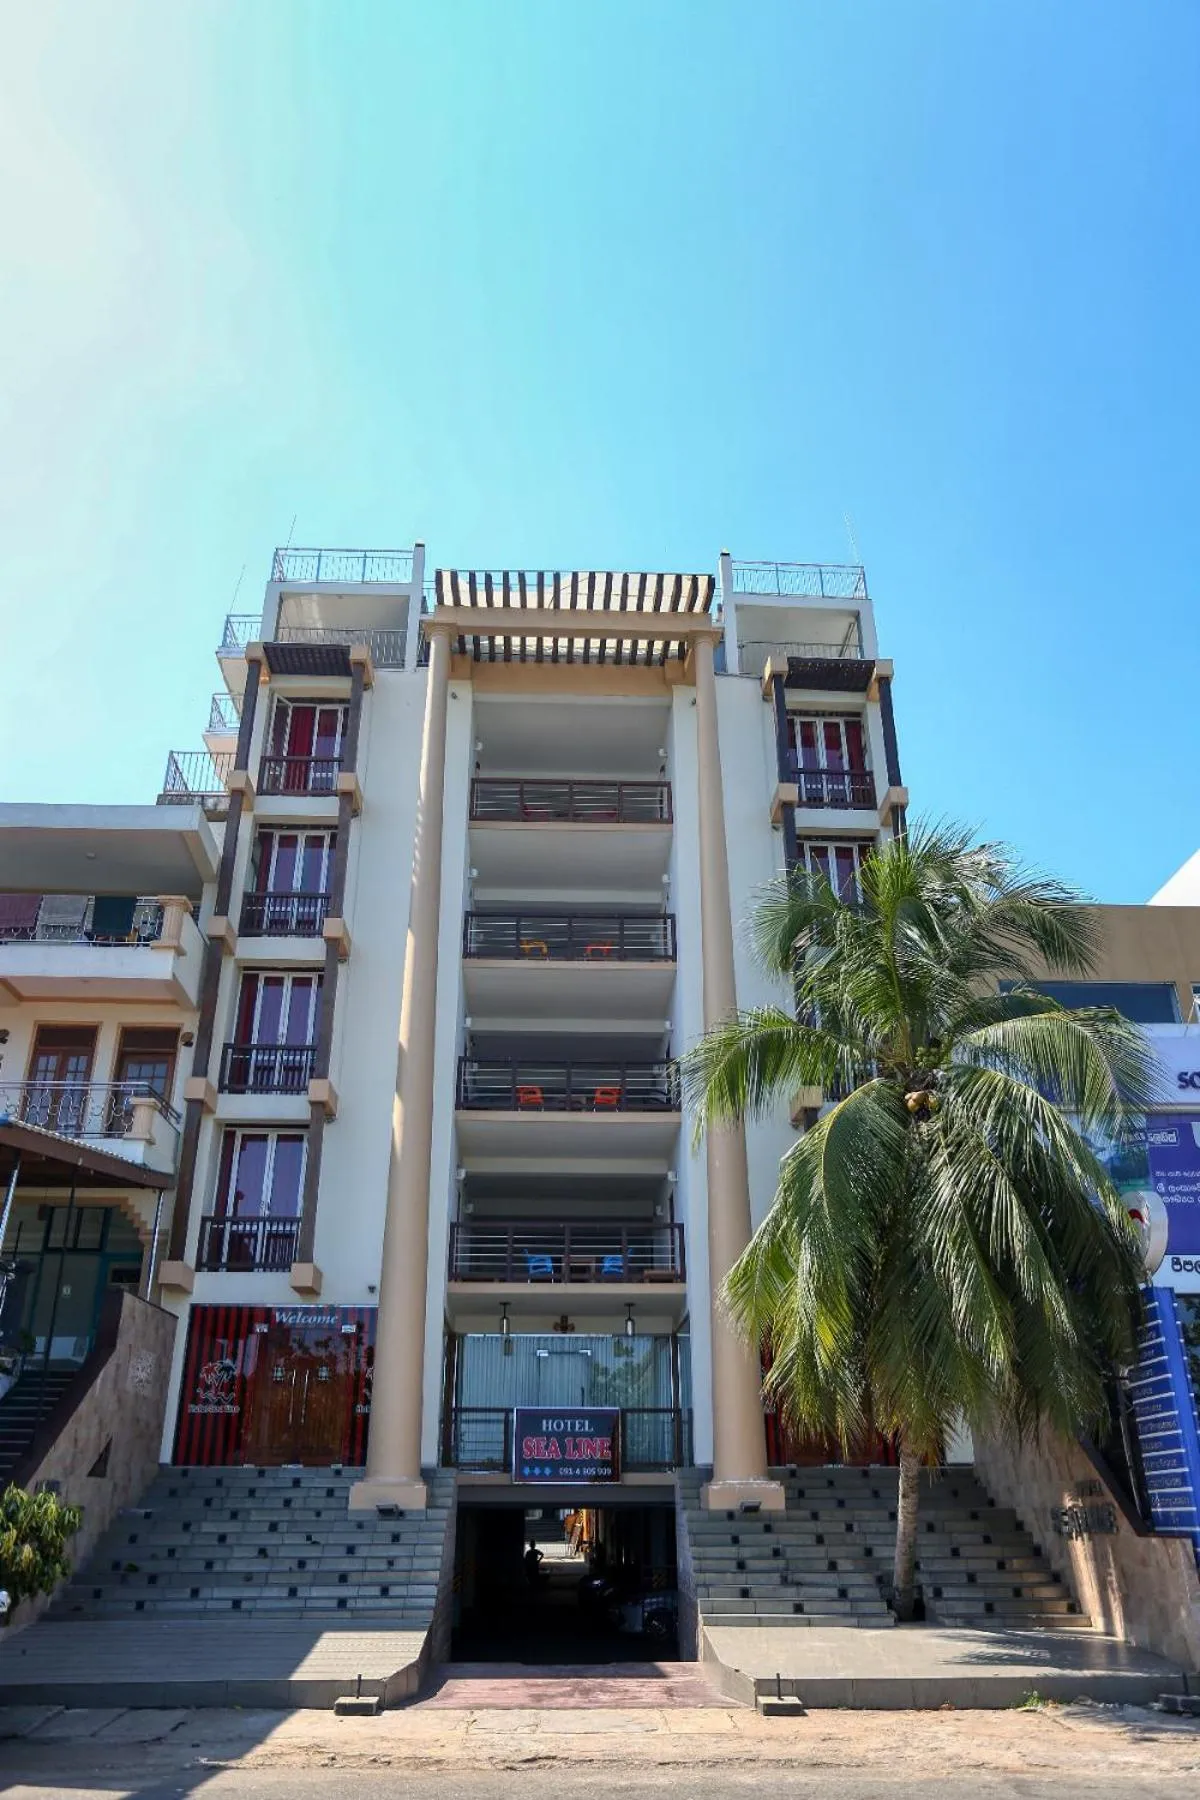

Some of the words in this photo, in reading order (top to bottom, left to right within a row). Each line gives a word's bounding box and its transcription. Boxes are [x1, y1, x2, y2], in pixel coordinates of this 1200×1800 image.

[275, 1311, 338, 1325] Welcome
[542, 1418, 594, 1433] HOTEL
[523, 1436, 561, 1460] SEA
[564, 1436, 612, 1460] LINE
